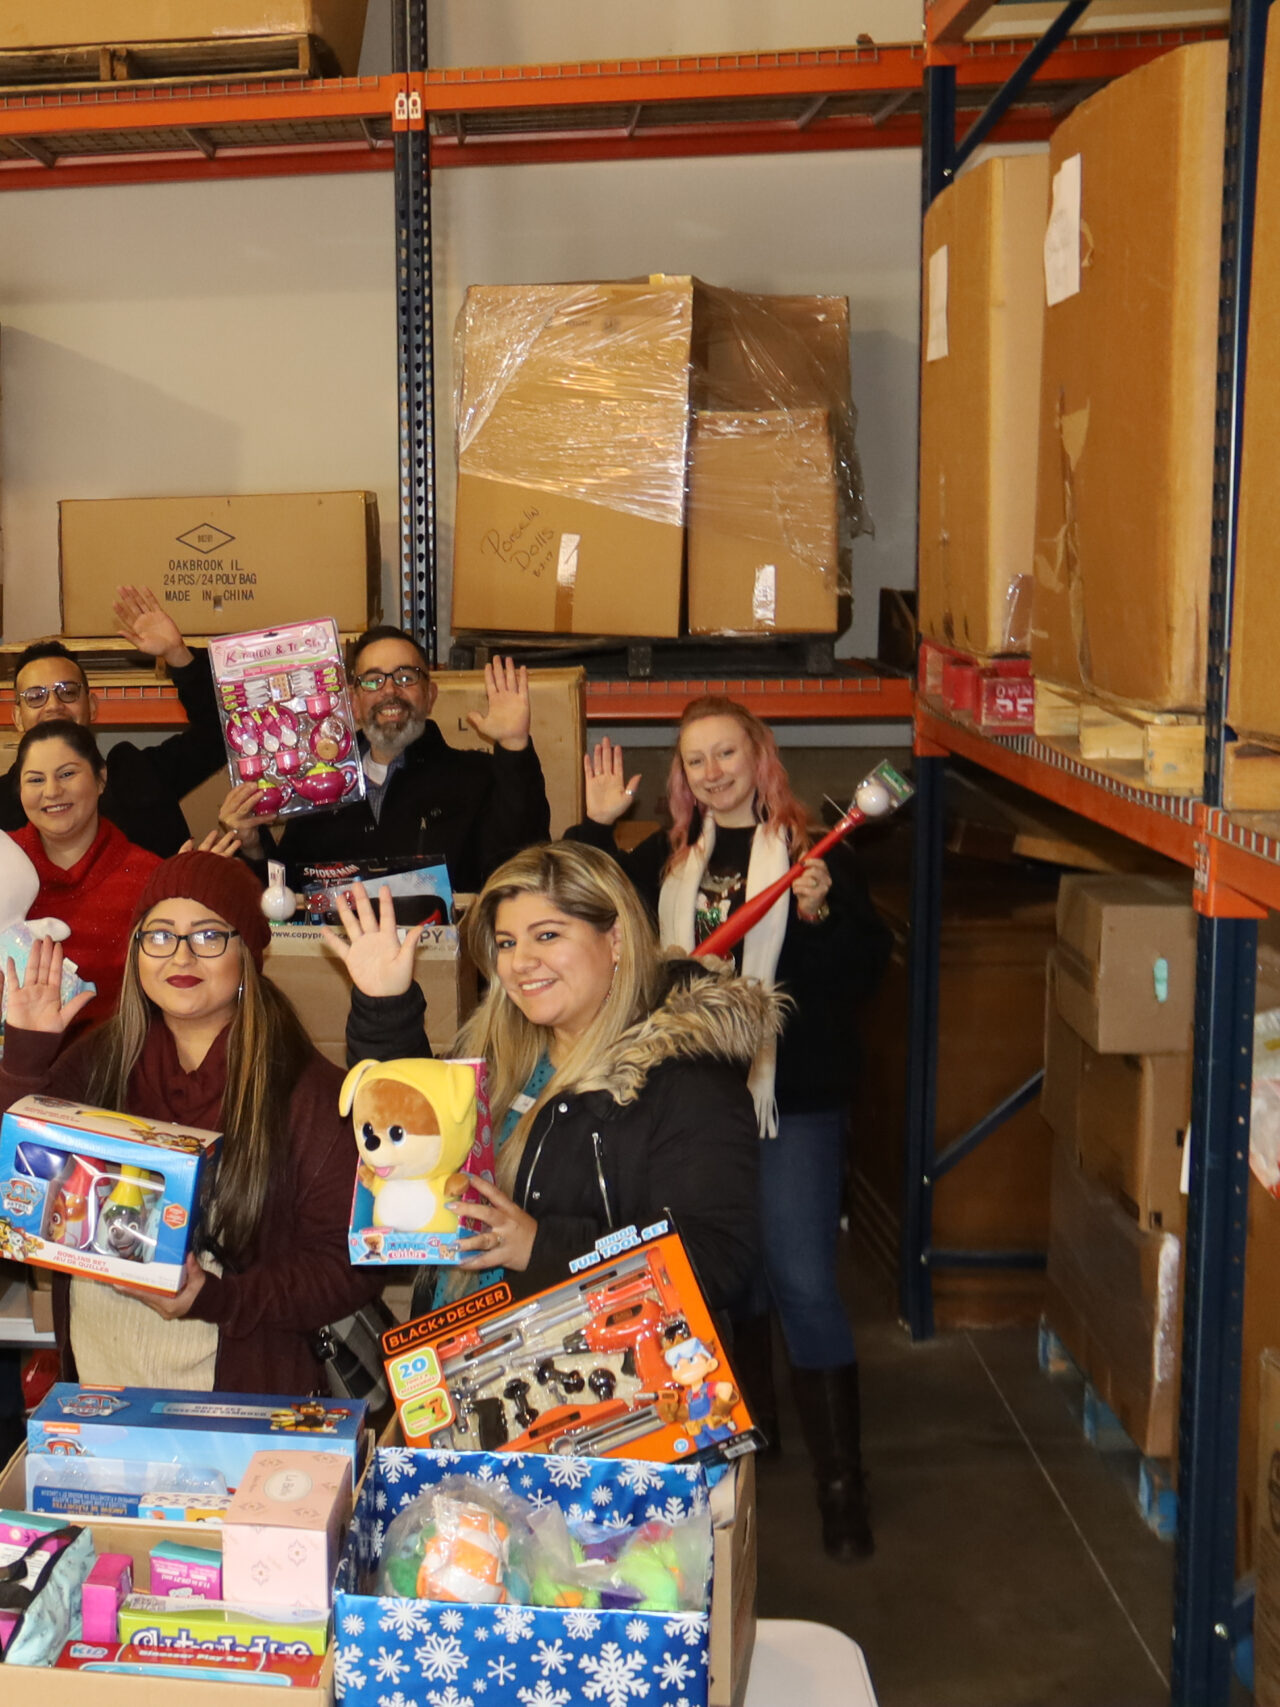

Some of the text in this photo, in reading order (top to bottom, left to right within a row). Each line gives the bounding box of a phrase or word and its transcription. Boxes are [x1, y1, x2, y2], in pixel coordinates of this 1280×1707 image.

[168, 559, 244, 571] OAKBROOK IL
[163, 573, 176, 586] 24
[215, 573, 238, 585] POLY
[239, 573, 257, 585] BAG
[165, 589, 255, 602] MADE IN CHINA
[303, 864, 361, 879] SPIDER-MAN
[595, 1225, 637, 1249] JUNIOR
[569, 1220, 668, 1274] FUN TOOL SET
[389, 1289, 505, 1347] BLACK+DECKER
[399, 1356, 428, 1380] 20
[138, 1649, 248, 1663] Dinosaur Play Set
